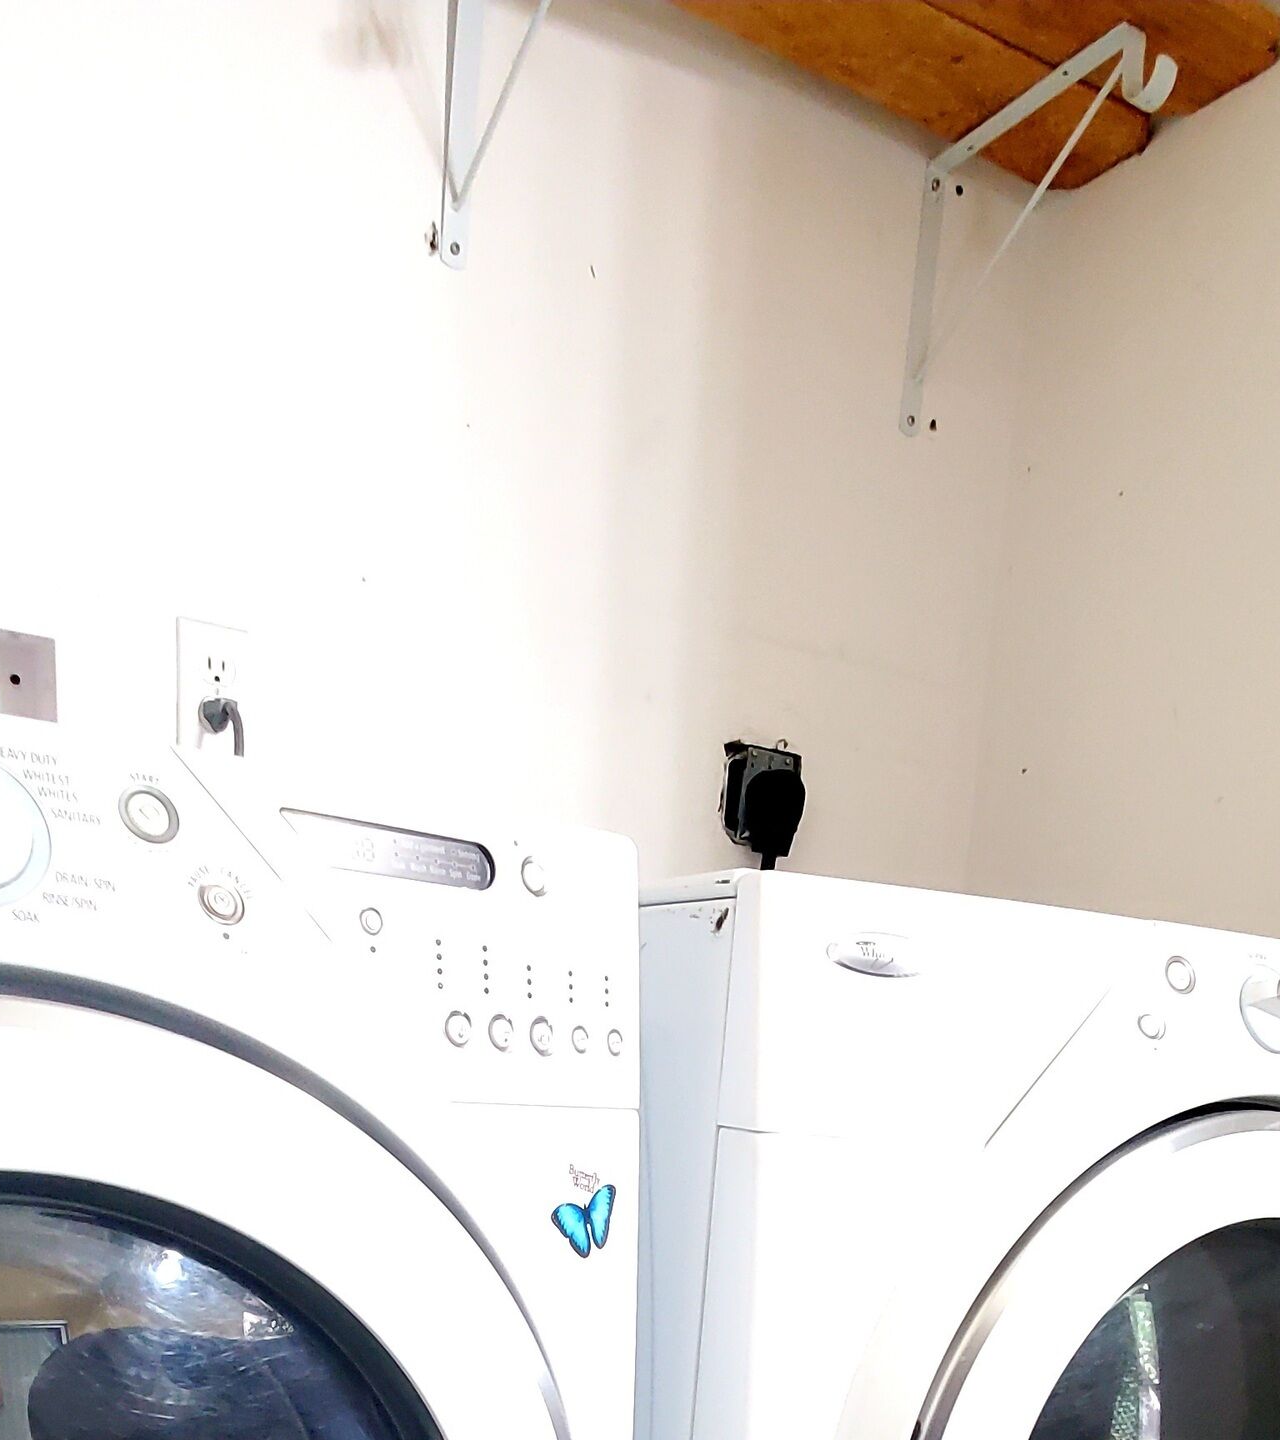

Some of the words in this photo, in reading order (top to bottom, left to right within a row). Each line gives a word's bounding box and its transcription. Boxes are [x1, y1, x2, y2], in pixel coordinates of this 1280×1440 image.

[30, 752, 58, 766] DUTY
[22, 769, 70, 786] WHITEST
[51, 807, 101, 825] SANITARY
[11, 909, 40, 923] SOAK
